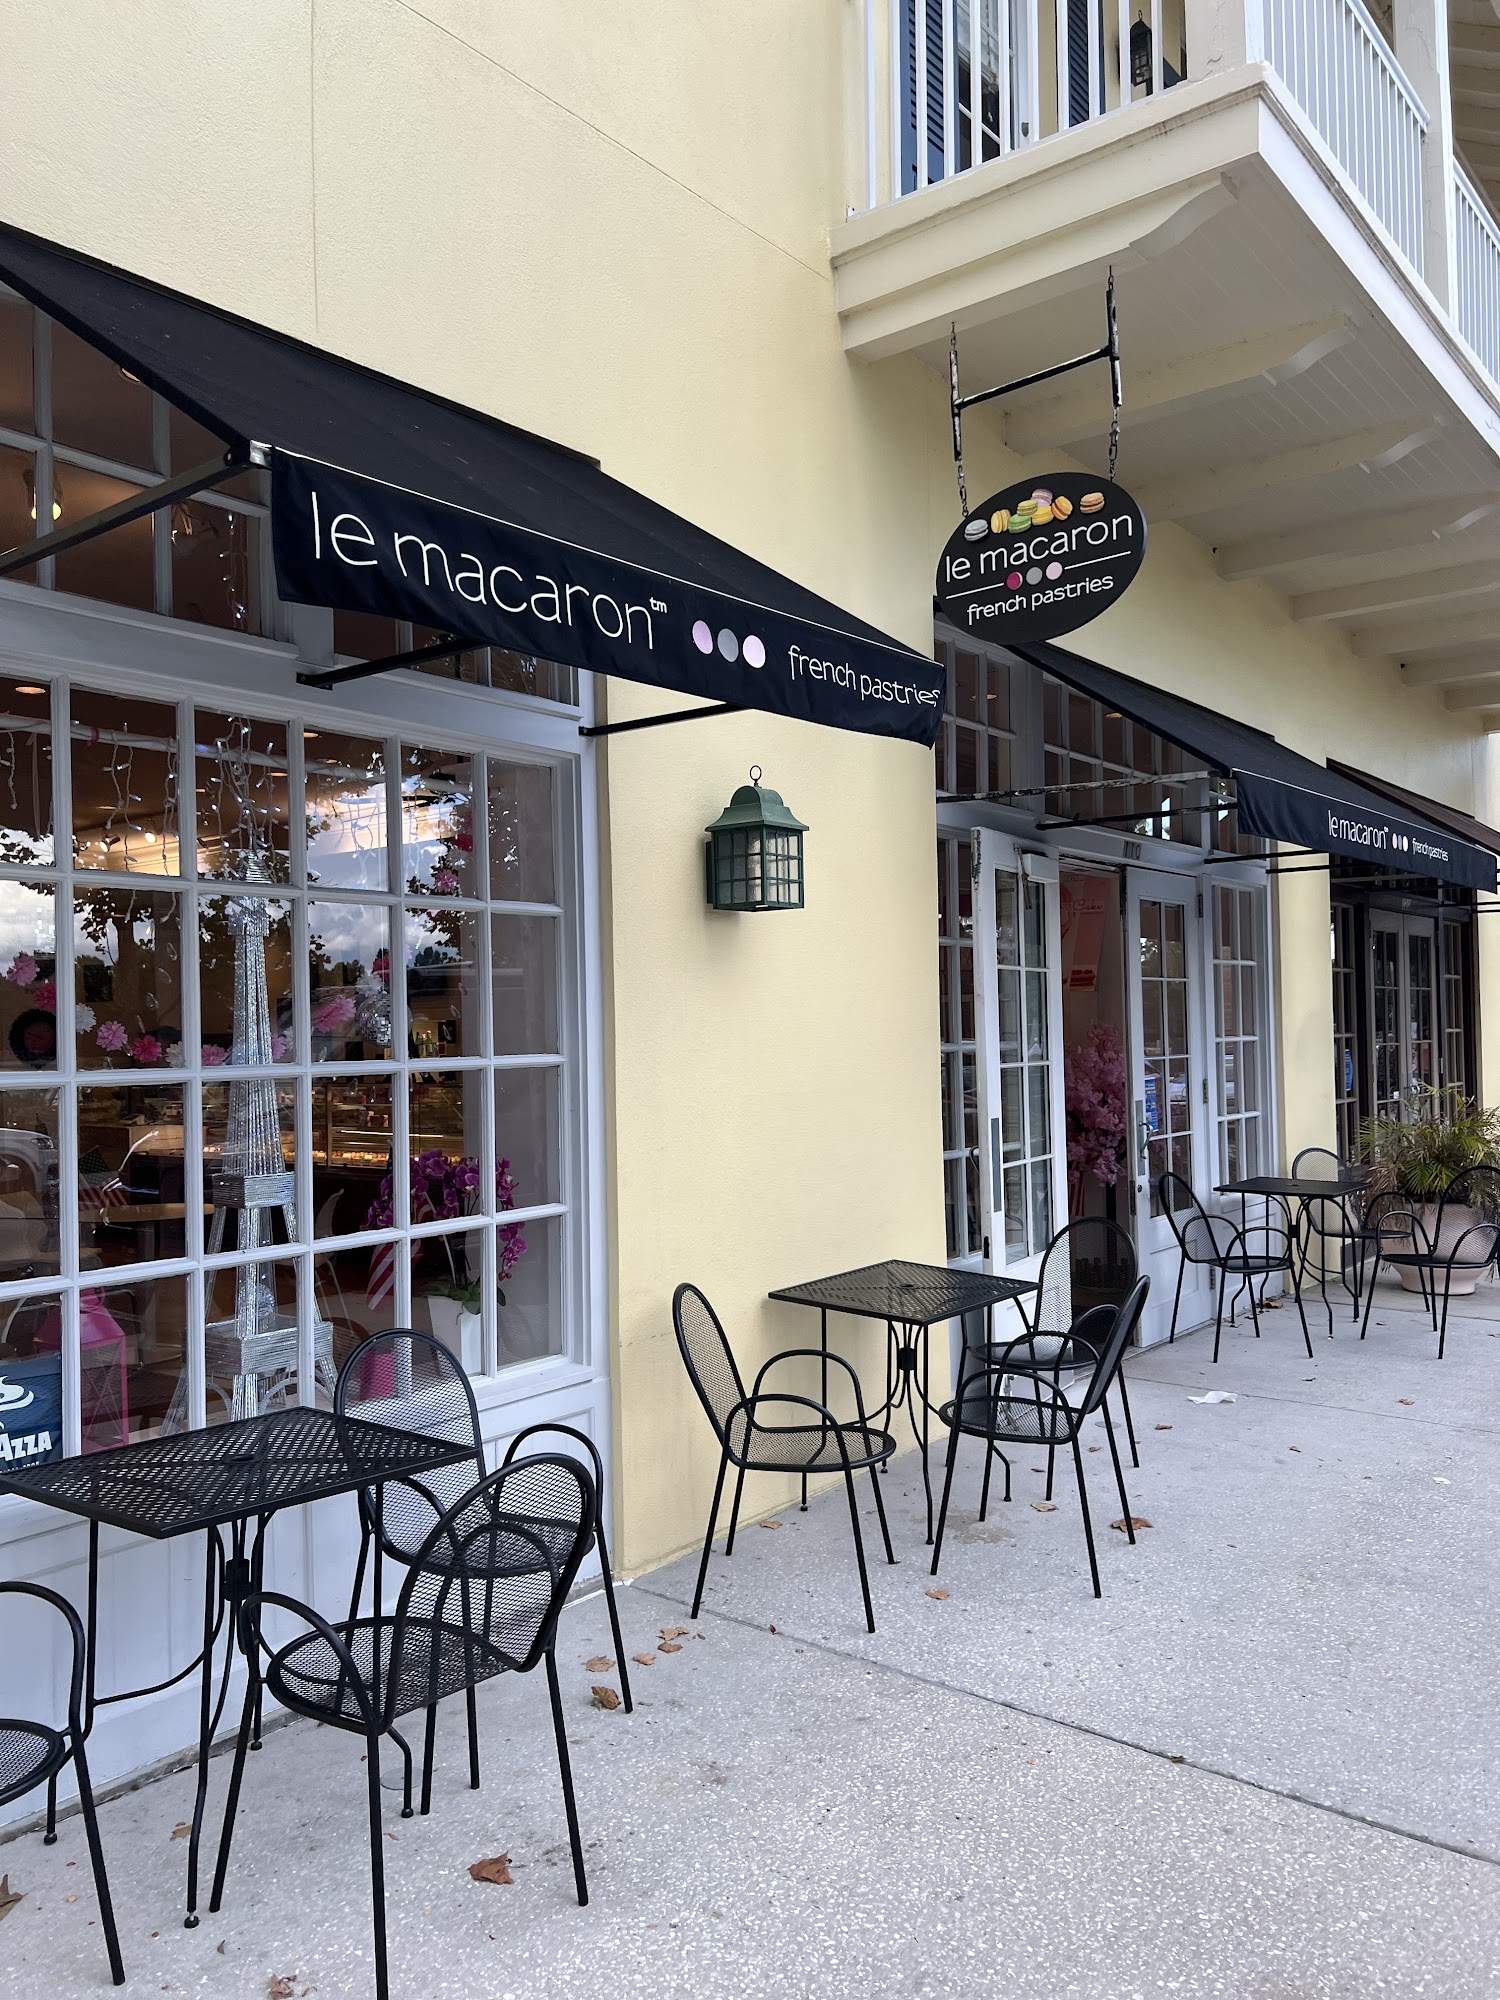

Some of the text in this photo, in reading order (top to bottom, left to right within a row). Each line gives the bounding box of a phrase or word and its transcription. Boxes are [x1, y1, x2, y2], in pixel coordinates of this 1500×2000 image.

[311, 491, 379, 566] le
[393, 532, 654, 650] macaron
[945, 514, 1133, 583] le macaron
[967, 574, 1114, 626] french pastries
[787, 644, 941, 708] french pastries
[1328, 810, 1387, 850] le macaron
[1412, 837, 1449, 862] french pastries
[1072, 897, 1103, 911] Cake
